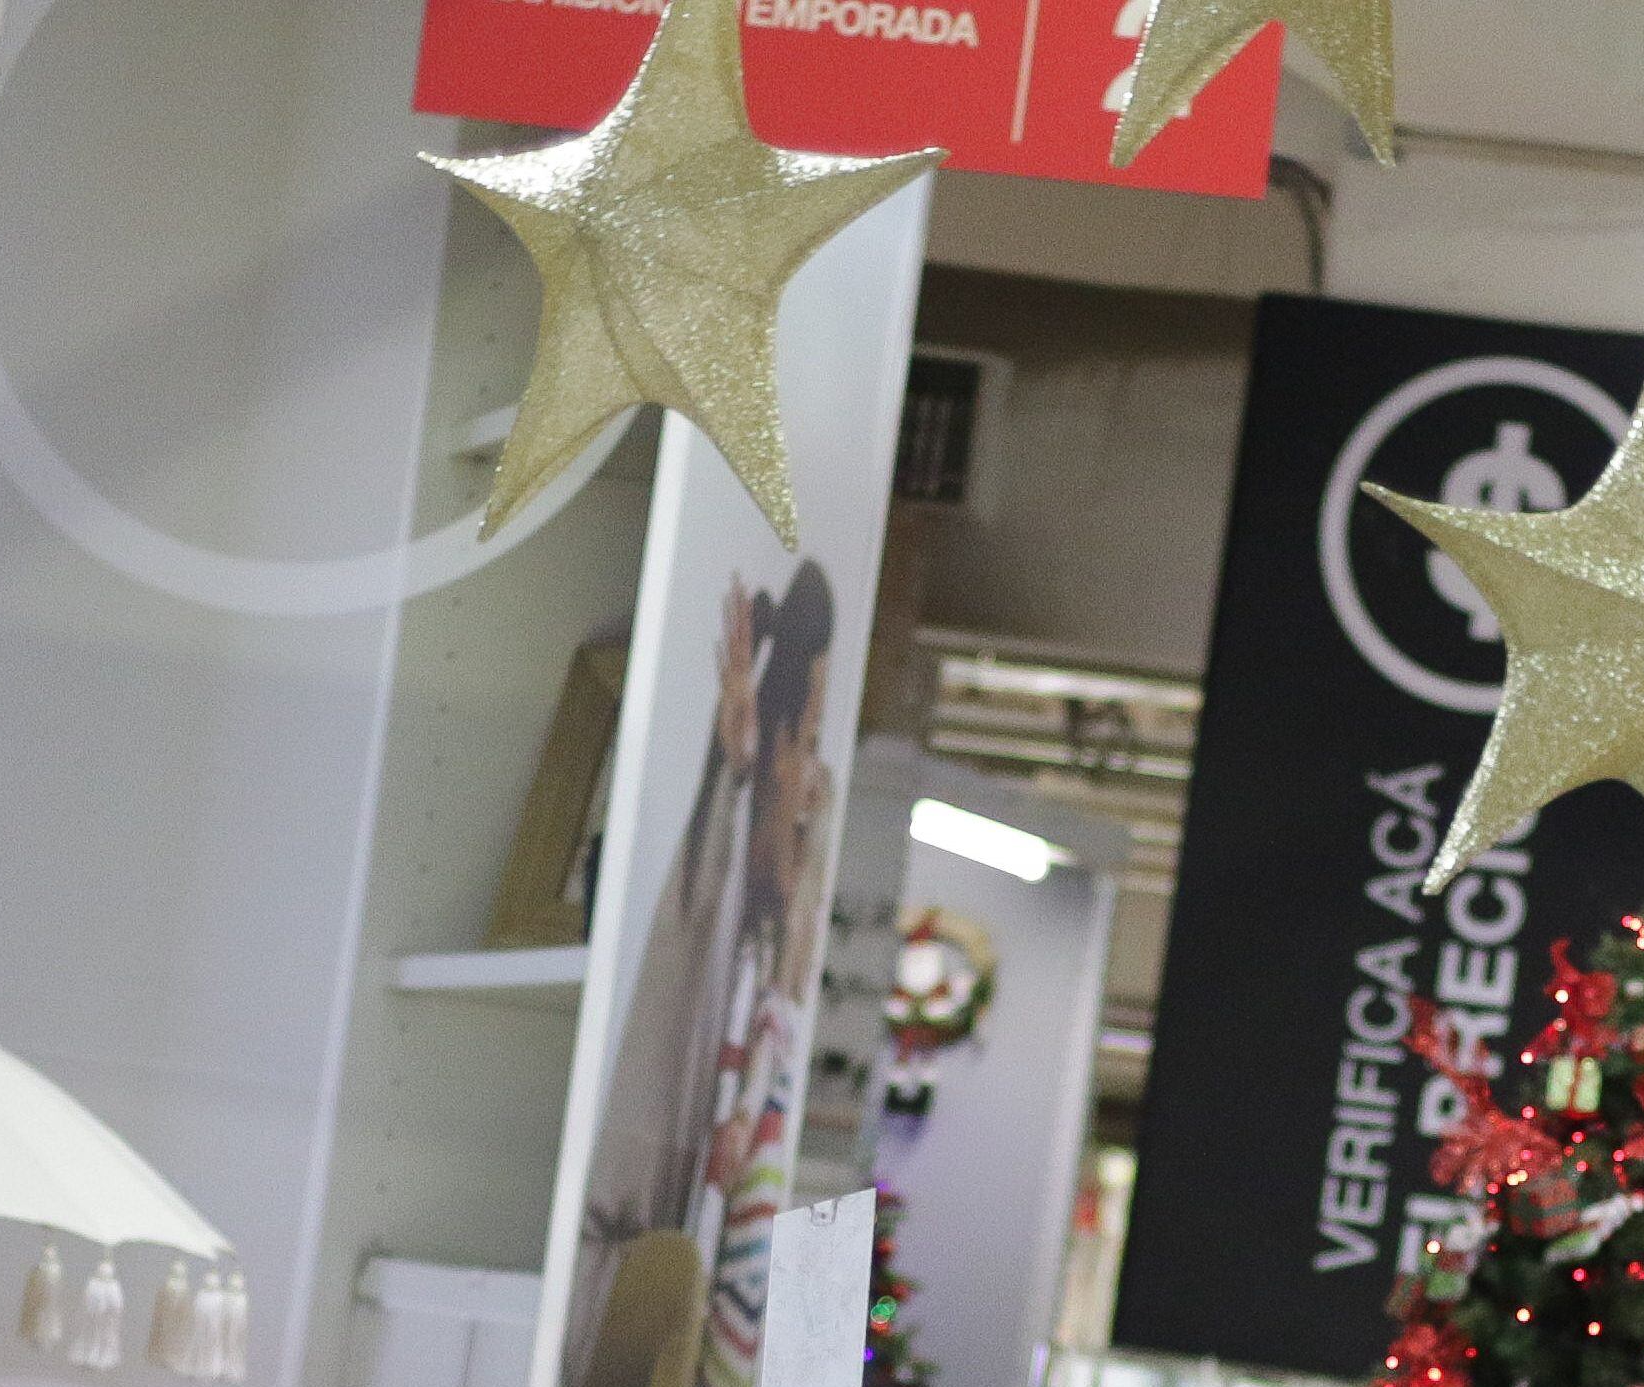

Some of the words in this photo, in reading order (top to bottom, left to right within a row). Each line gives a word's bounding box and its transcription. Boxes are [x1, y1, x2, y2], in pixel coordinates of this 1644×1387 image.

[741, 0, 980, 48] EMPORADA
[1366, 762, 1444, 924] ACÁ
[1417, 806, 1541, 1138] PRECI
[1313, 939, 1420, 1272] VERIFICA
